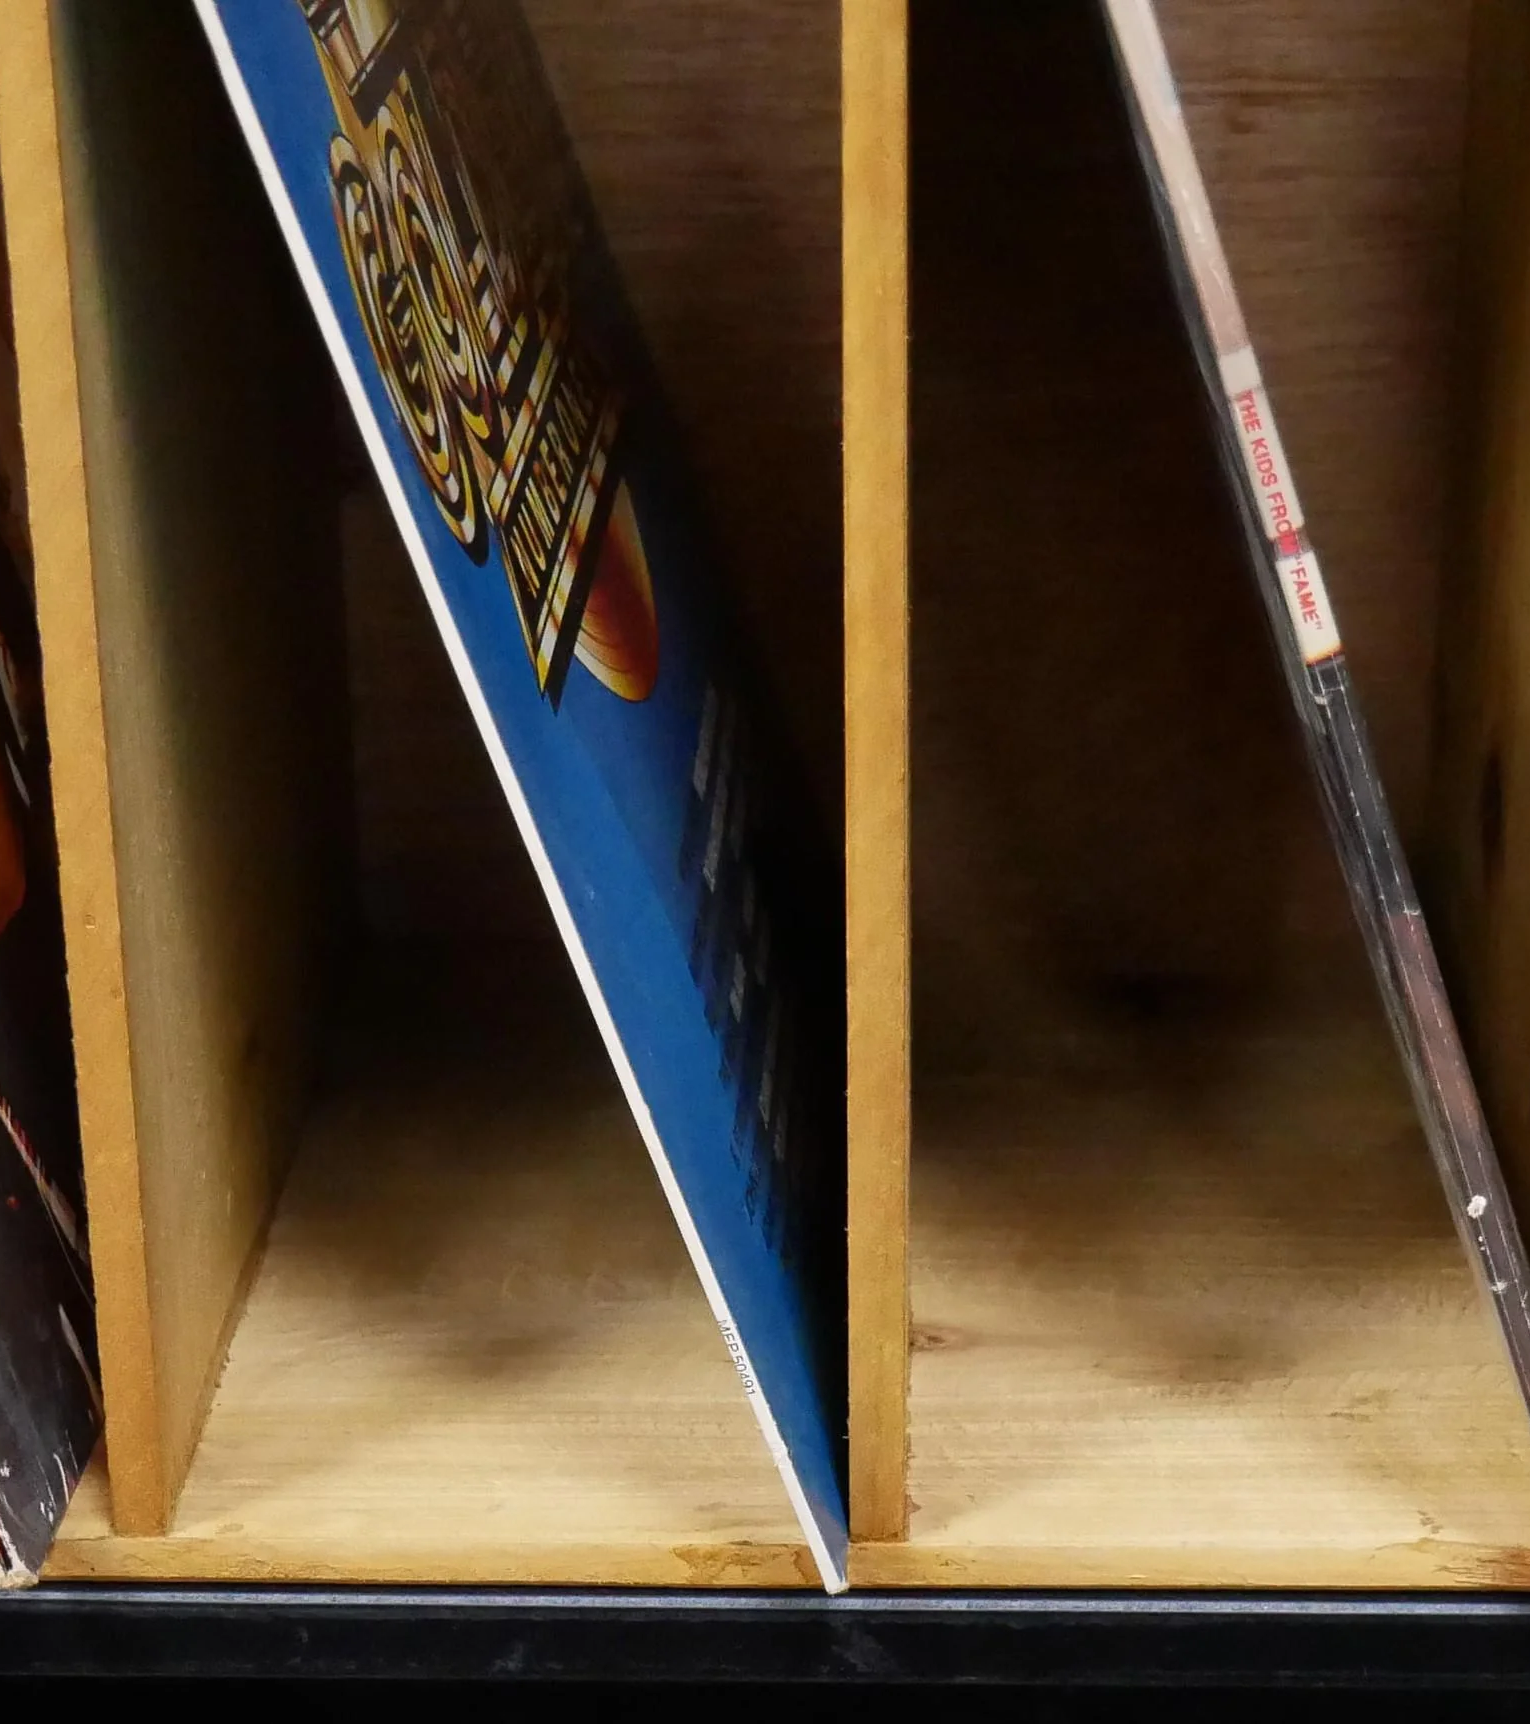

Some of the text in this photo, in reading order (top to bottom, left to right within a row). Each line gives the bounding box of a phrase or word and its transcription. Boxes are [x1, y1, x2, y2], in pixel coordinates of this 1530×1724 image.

[1235, 389, 1262, 433] THE
[1251, 438, 1278, 487] KIDS
[510, 421, 573, 600] NUMBER
[717, 1319, 755, 1395] MFP 50491
